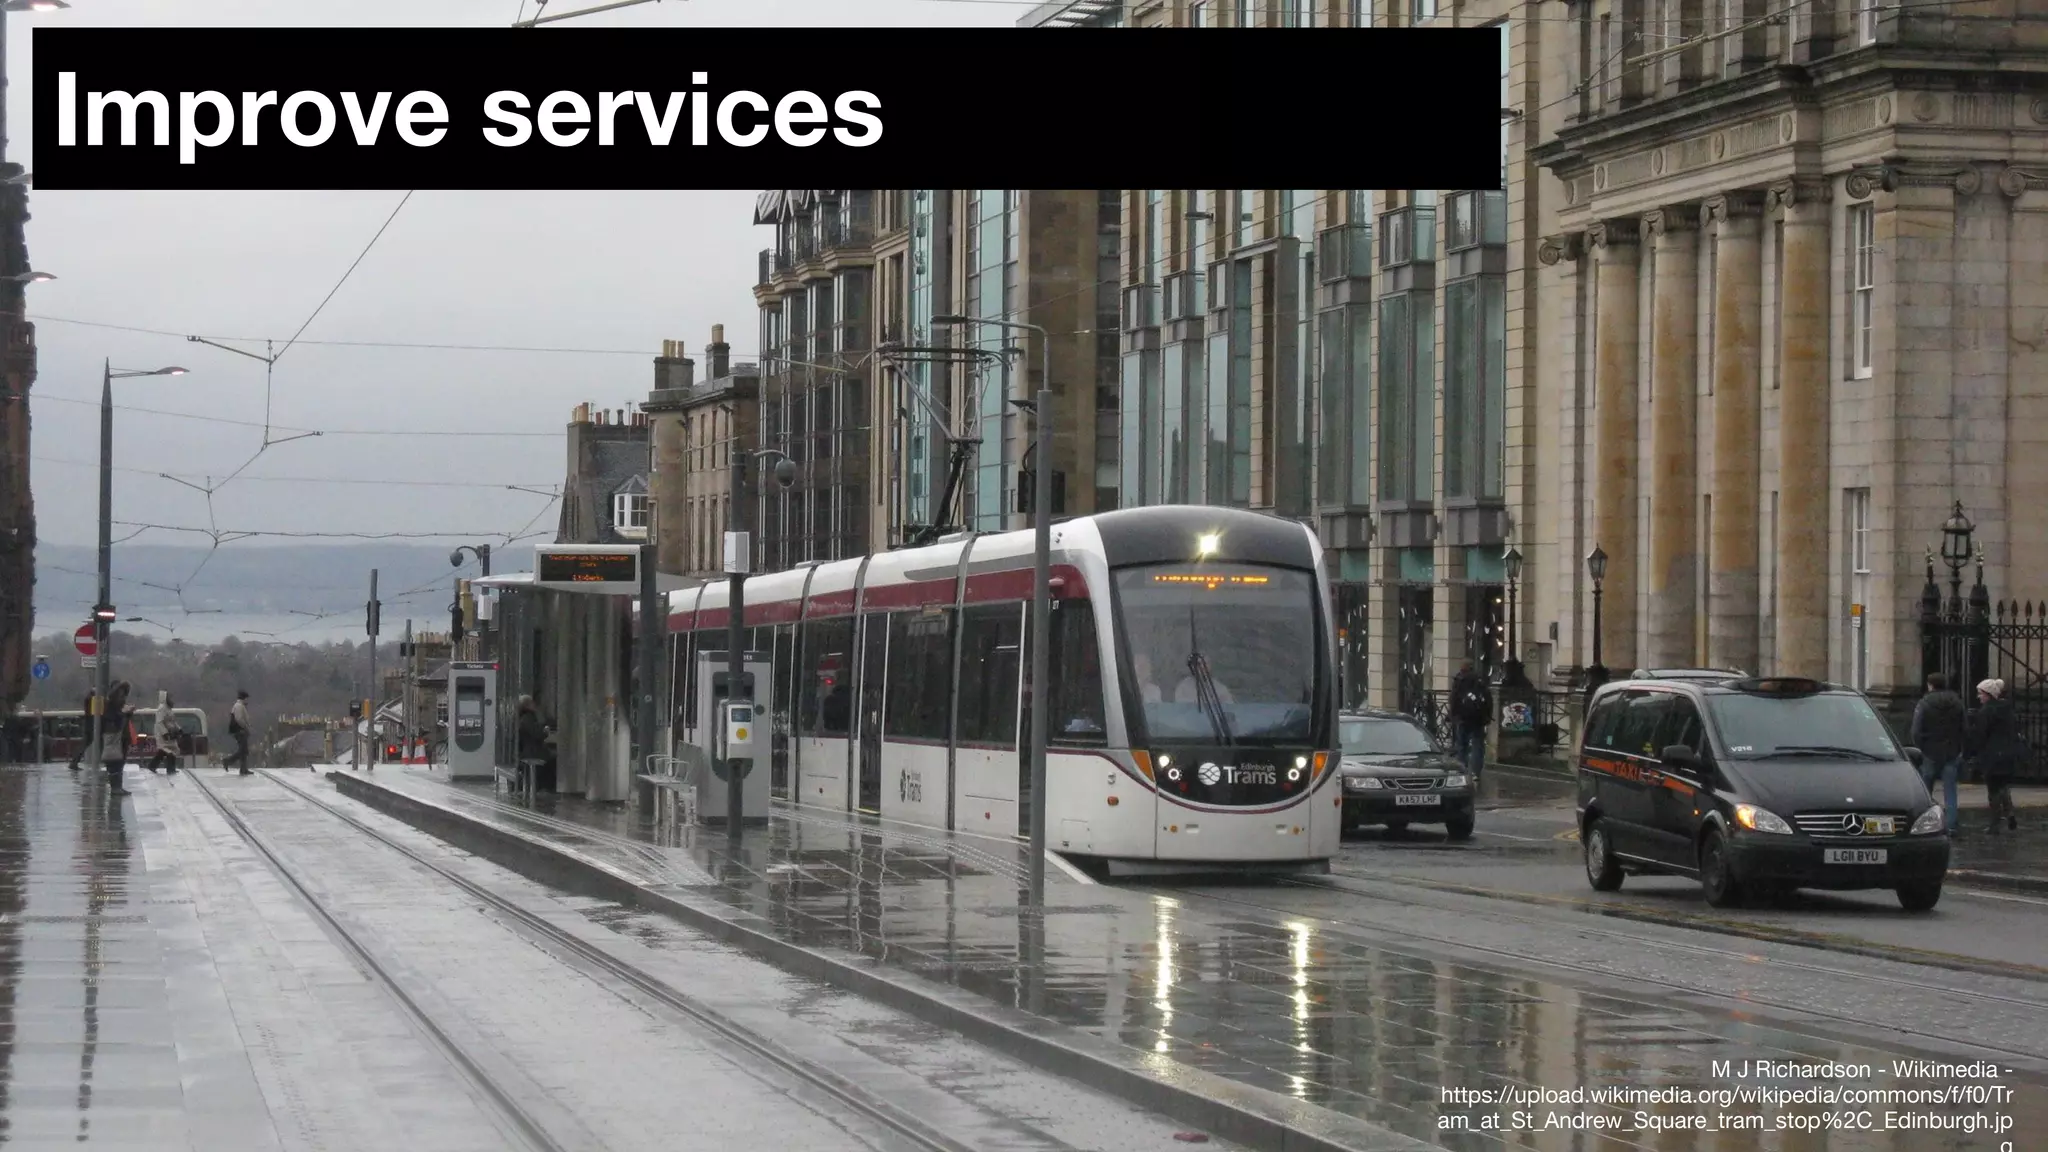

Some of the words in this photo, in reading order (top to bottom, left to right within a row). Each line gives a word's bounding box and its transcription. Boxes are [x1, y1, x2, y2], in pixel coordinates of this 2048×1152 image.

[1240, 763, 1275, 772] Edinburgh
[1223, 766, 1277, 784] Trams
[1857, 850, 1879, 862] BYU
